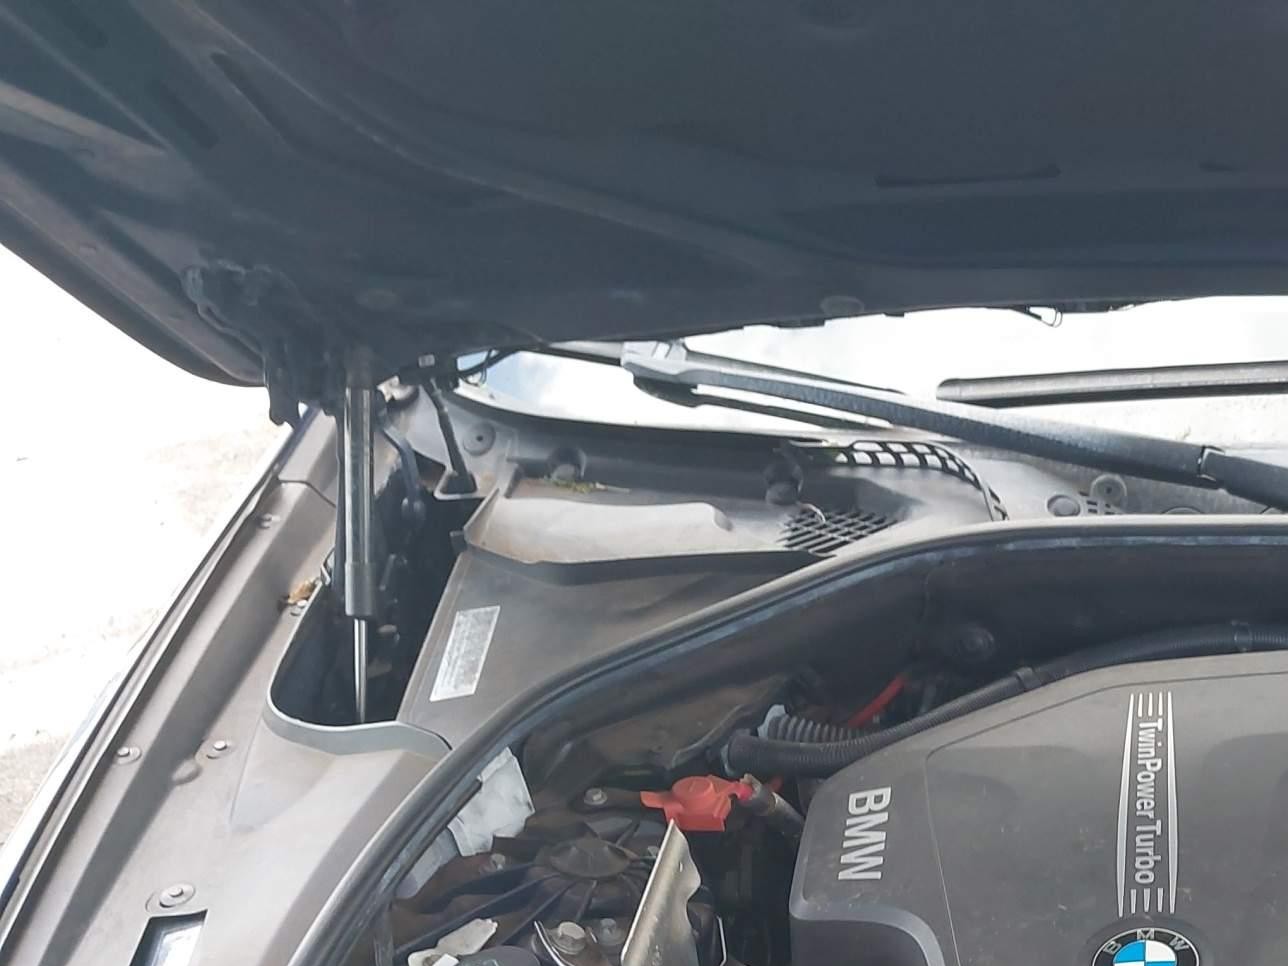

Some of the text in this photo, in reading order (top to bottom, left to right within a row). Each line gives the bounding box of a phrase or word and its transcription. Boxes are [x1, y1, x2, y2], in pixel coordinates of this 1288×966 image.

[838, 786, 892, 880] BMW
[1134, 717, 1163, 885] TwinPower Turbo
[1102, 928, 1190, 956] BMW
